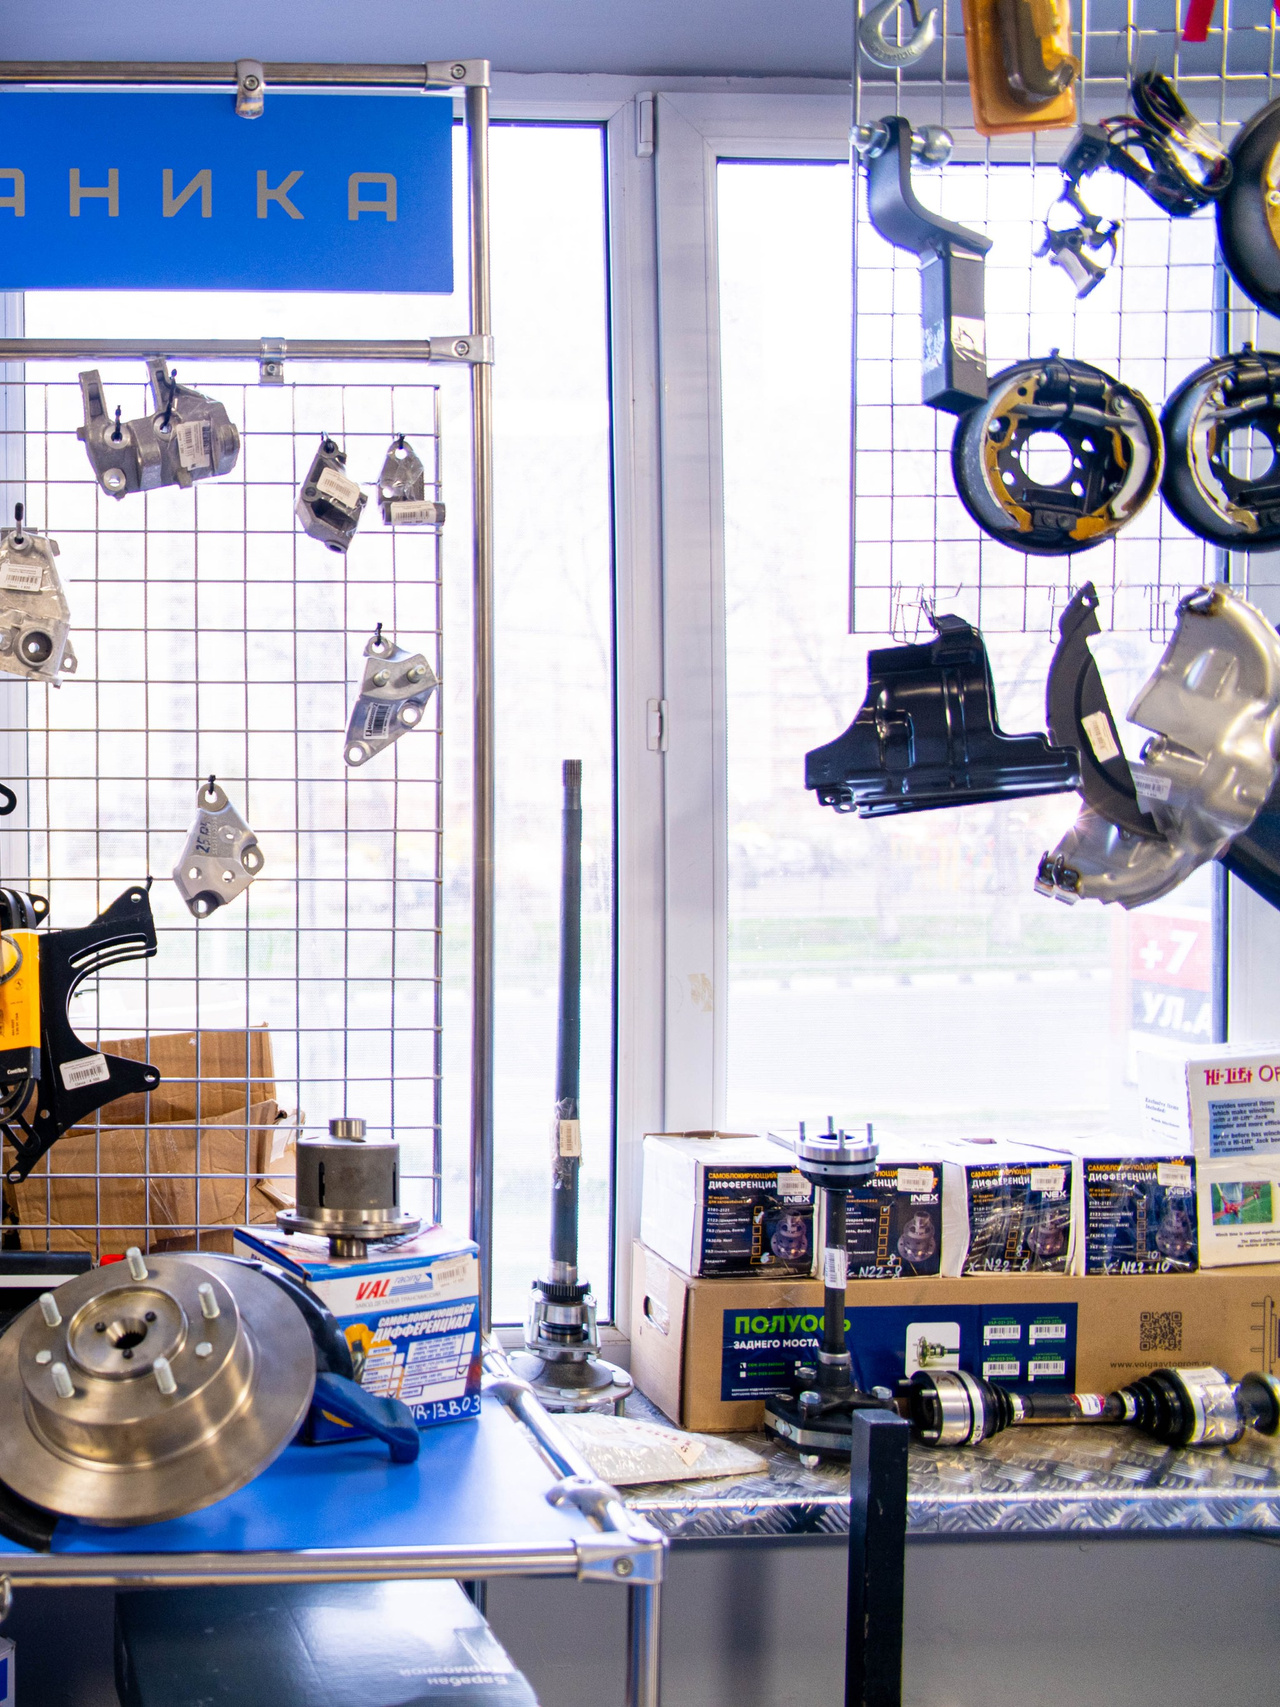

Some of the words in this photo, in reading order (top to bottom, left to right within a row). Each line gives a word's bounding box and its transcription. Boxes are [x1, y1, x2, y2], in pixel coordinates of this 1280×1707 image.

[1203, 1067, 1253, 1086] Hi-Lift
[708, 1171, 778, 1179] САМОБЛОКИРУЮЩИЙ
[1088, 1173, 1157, 1182] ДИФФЕРЕНЦИА
[708, 1181, 777, 1190] ДИФФЕРЕНЦИА
[971, 1176, 1030, 1189] ДИФФЕРЕНЦИ
[1165, 1187, 1192, 1195] INEX
[783, 1195, 810, 1203] INEX
[910, 1194, 939, 1202] INEX
[355, 1279, 390, 1301] VAL
[378, 1303, 475, 1327] САМОБЛОКИРУЮЩИЙСЯ
[371, 1314, 472, 1344] ДИФФЕРЕНЦИАЛ
[734, 1340, 780, 1350] ЗАДНЕГО
[783, 1338, 819, 1347] МОСТА
[426, 1674, 509, 1687] Барабан
